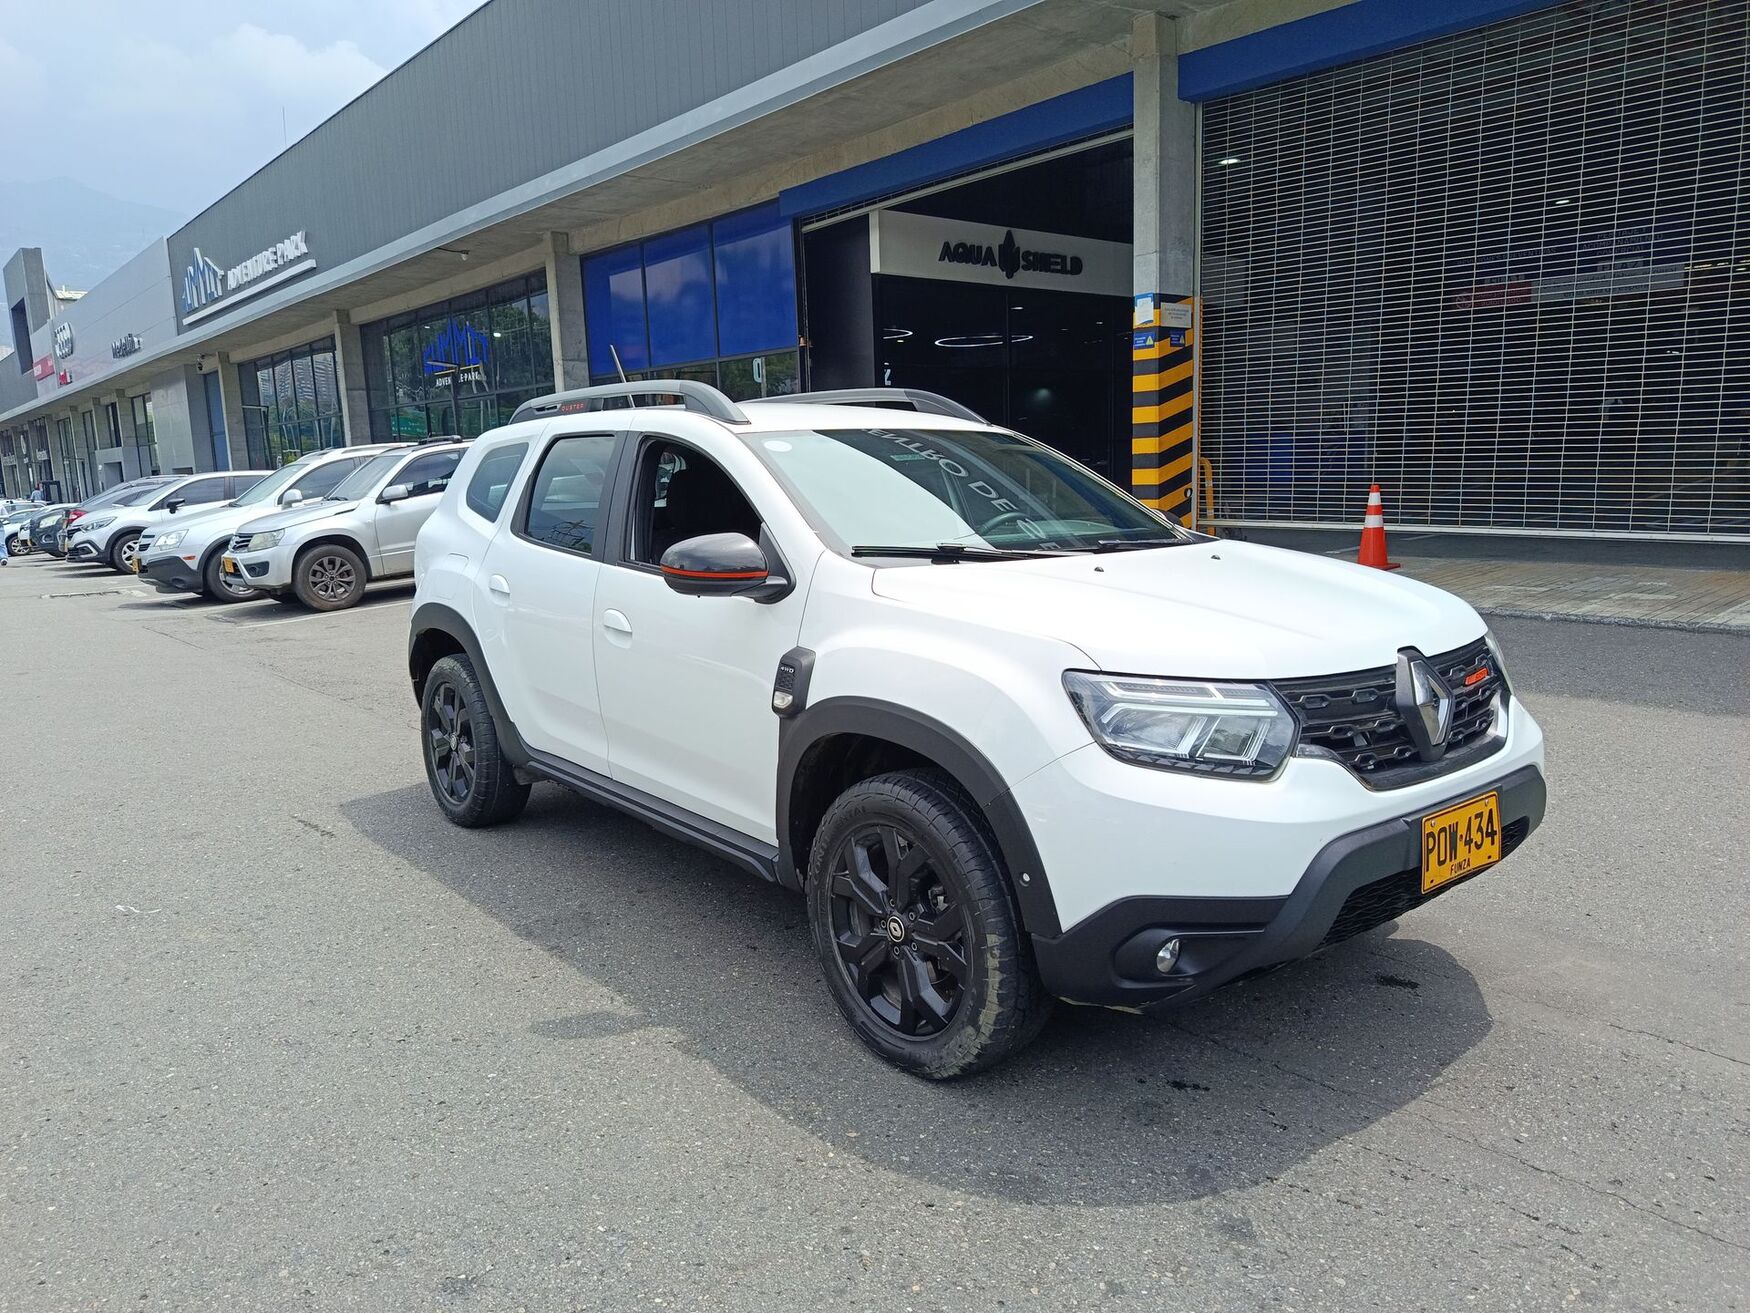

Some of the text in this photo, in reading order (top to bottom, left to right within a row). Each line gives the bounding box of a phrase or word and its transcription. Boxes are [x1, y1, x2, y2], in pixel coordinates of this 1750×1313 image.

[938, 241, 1083, 275] AQUA SHIELD
[1449, 857, 1471, 876] FUNZA
